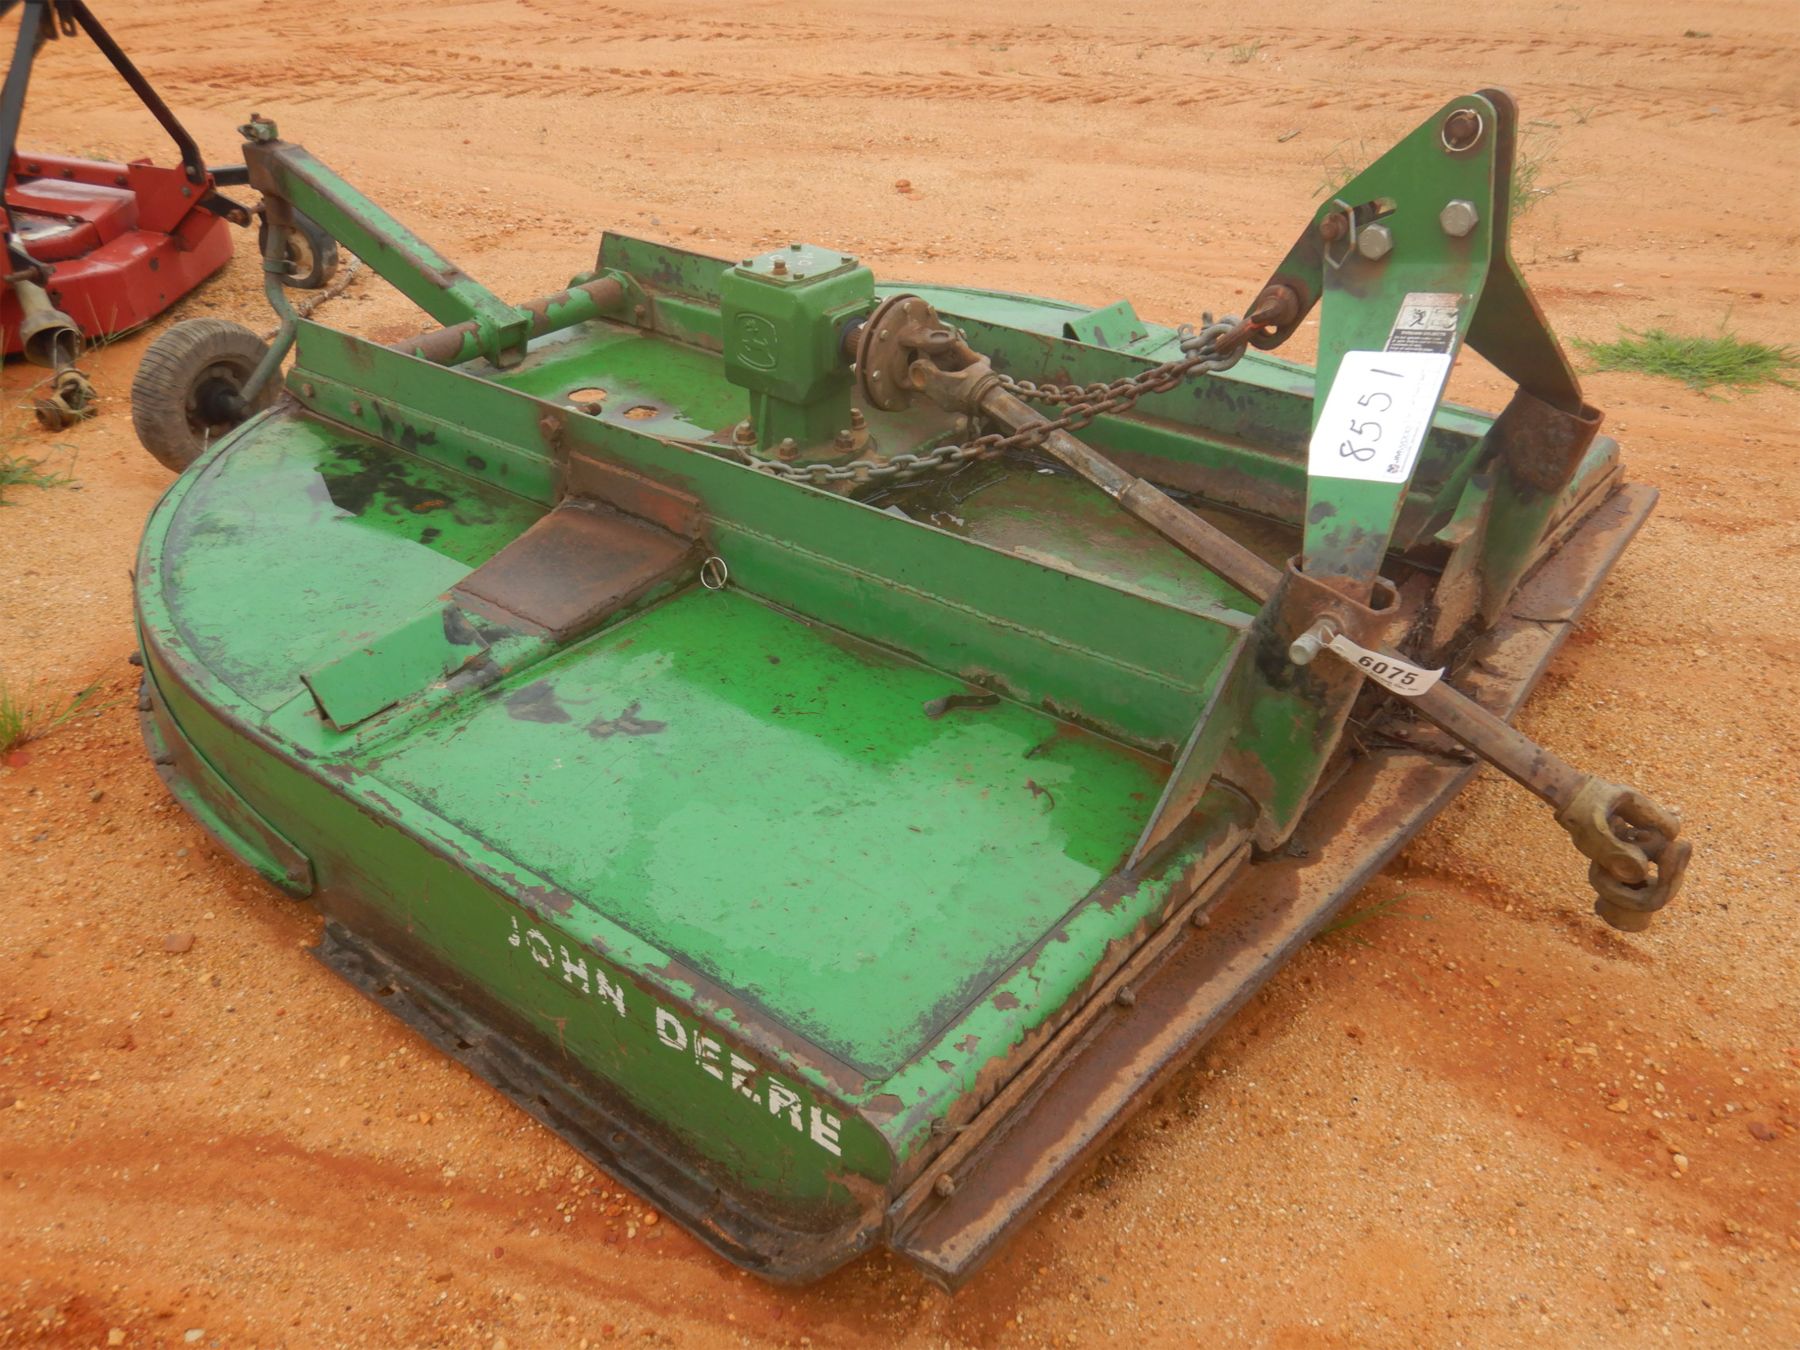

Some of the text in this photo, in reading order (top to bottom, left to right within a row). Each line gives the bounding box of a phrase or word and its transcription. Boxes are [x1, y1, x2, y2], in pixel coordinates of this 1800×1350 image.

[1339, 368, 1405, 462] 8551
[1358, 655, 1419, 685] 6075
[656, 1006, 842, 1157] DEERE
